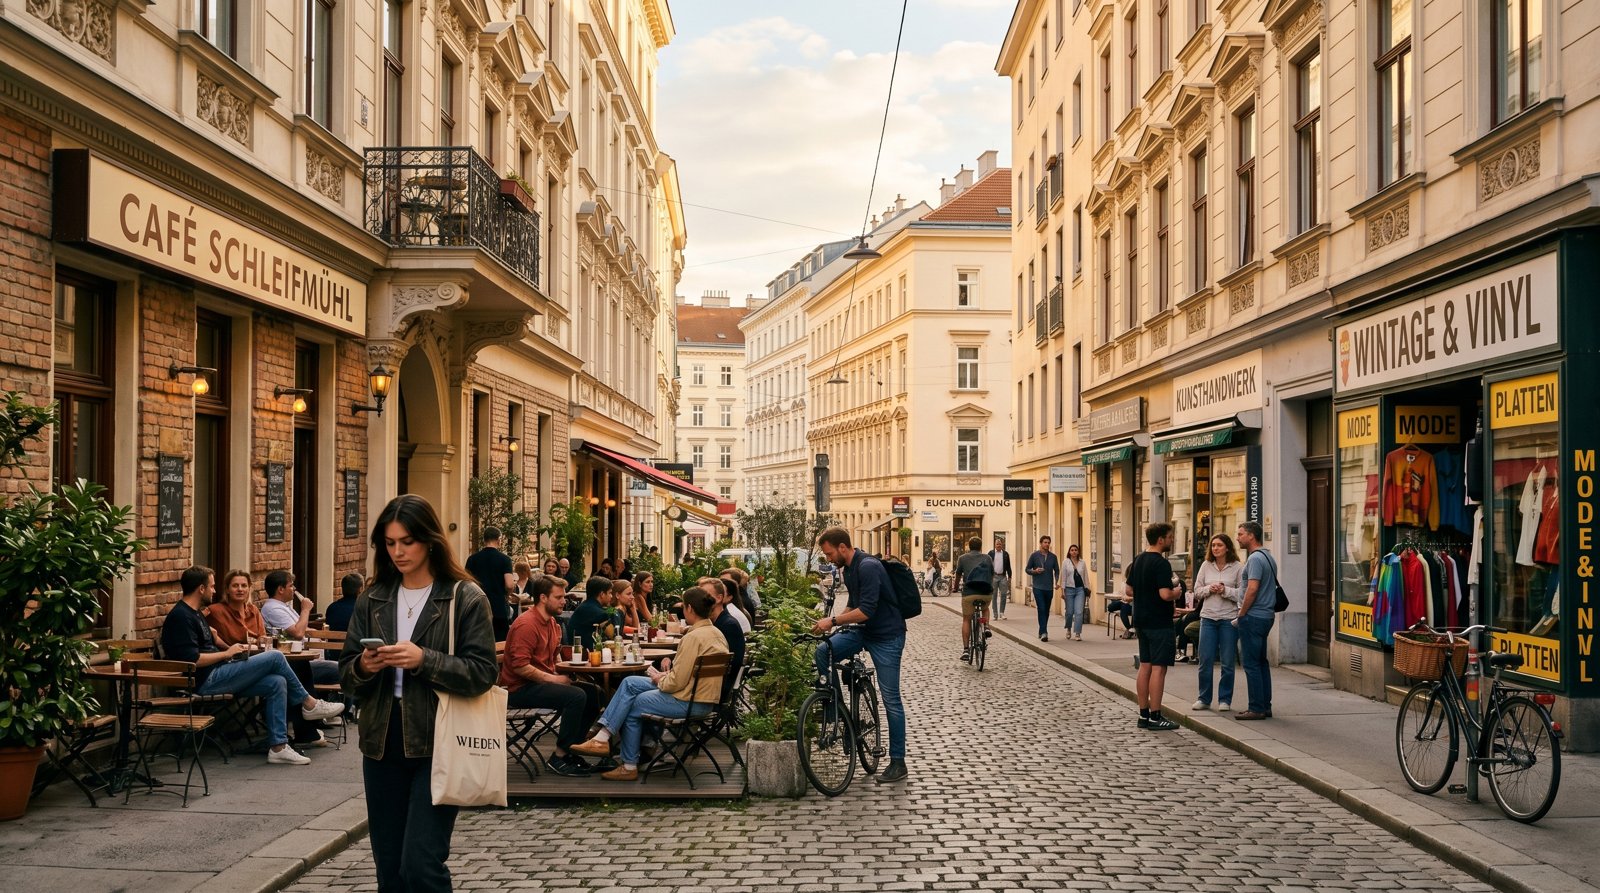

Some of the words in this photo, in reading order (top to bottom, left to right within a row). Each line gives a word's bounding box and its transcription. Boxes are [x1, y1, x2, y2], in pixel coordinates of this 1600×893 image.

[120, 193, 197, 265] CAFÉ
[209, 229, 353, 323] SCHLEIFMÜHL
[1354, 305, 1436, 378] WINTAGE
[1443, 300, 1459, 356] &
[1466, 273, 1541, 350] VINYL
[1176, 365, 1257, 413] KUNSTHANDWERK
[1496, 382, 1555, 419] PLATTEN
[1347, 415, 1372, 439] MODE
[1400, 415, 1456, 436] MODE
[926, 499, 1011, 507] EUCHNANDLUNG
[456, 735, 501, 750] WIEDEN
